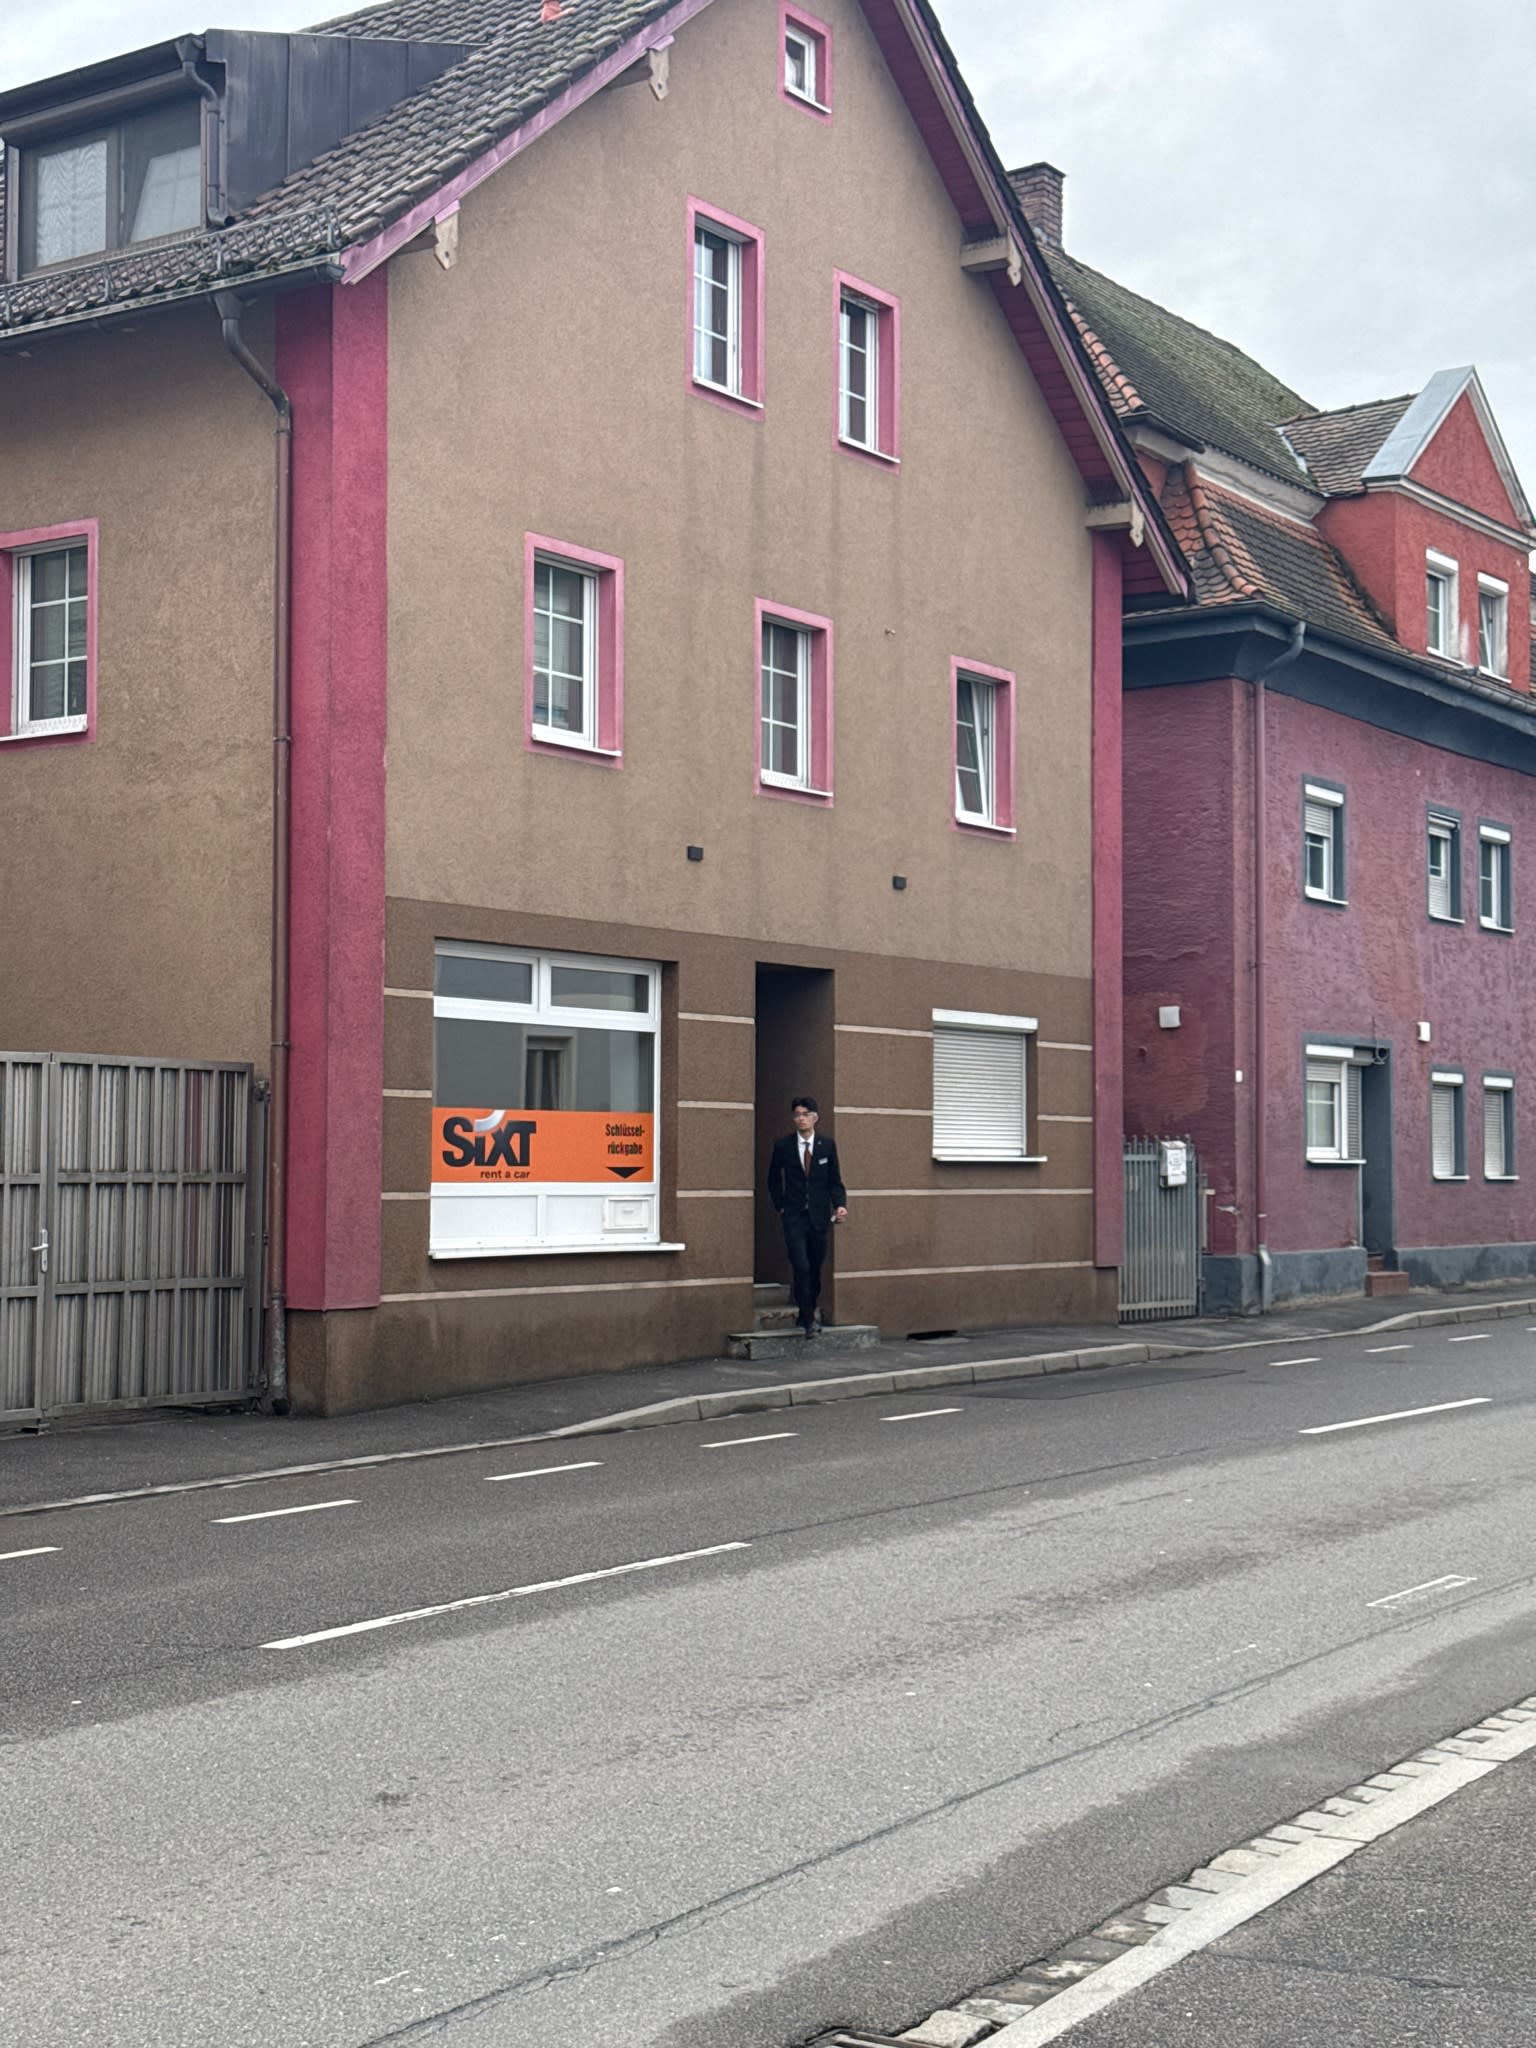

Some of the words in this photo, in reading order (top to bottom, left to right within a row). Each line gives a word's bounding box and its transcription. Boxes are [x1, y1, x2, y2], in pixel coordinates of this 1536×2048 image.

[605, 1123, 645, 1137] Schlüssel-
[607, 1141, 643, 1156] rückgabe
[480, 1169, 502, 1179] rent
[504, 1171, 511, 1179] a
[513, 1171, 530, 1179] car
